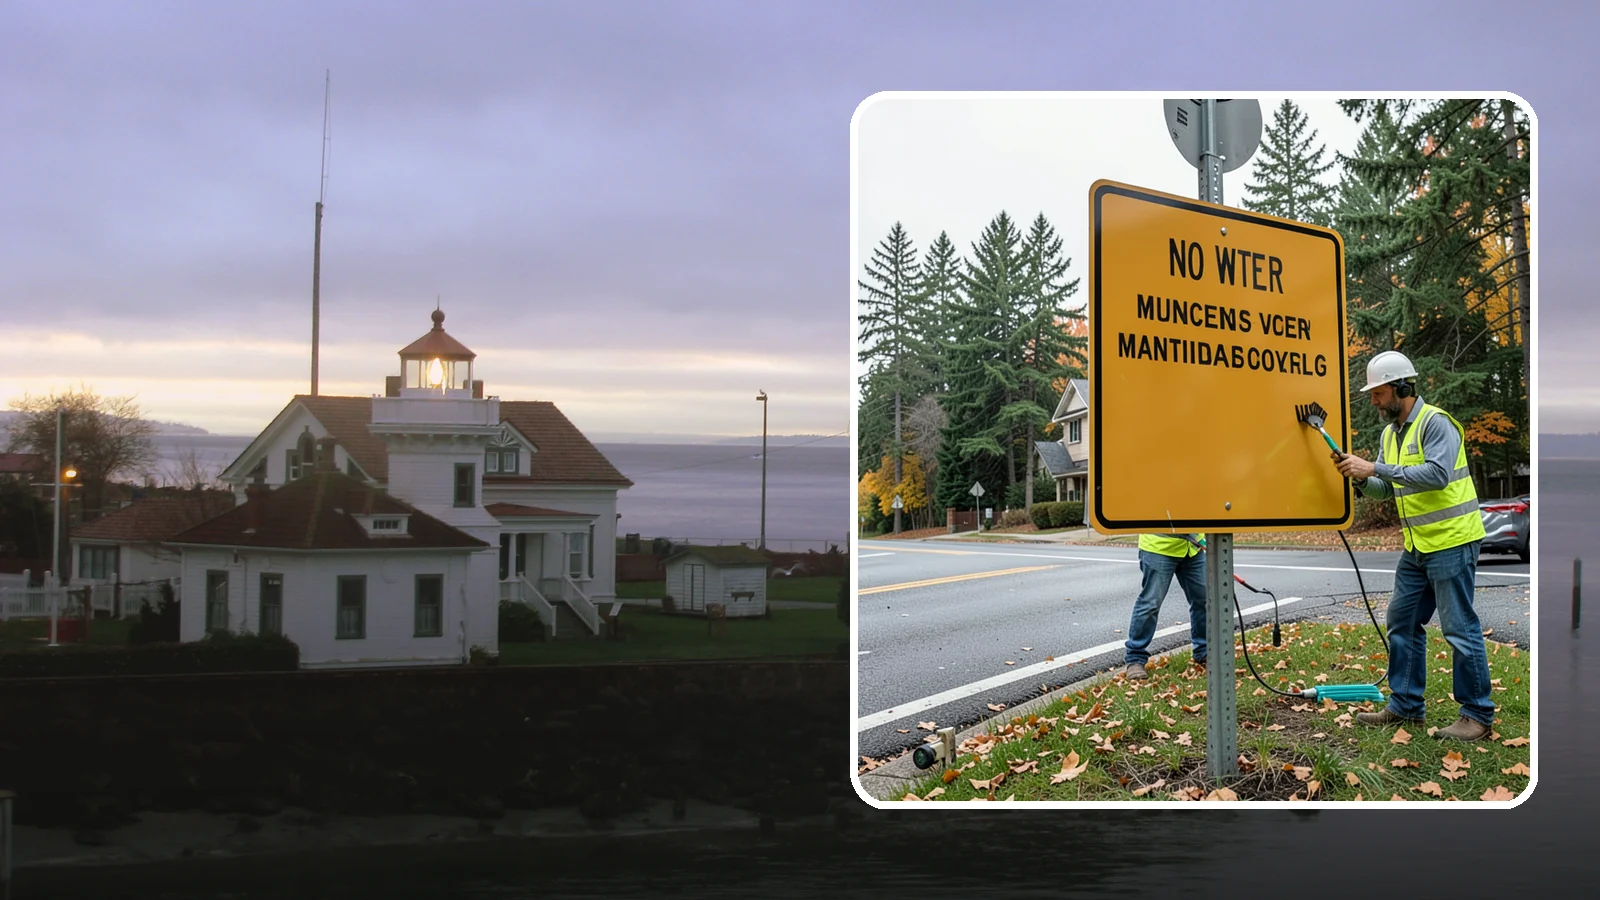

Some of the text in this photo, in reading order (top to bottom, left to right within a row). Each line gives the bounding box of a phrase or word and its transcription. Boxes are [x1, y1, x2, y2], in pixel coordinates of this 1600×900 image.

[1169, 237, 1284, 295] NO WTER
[1137, 293, 1252, 333] MUNCENS
